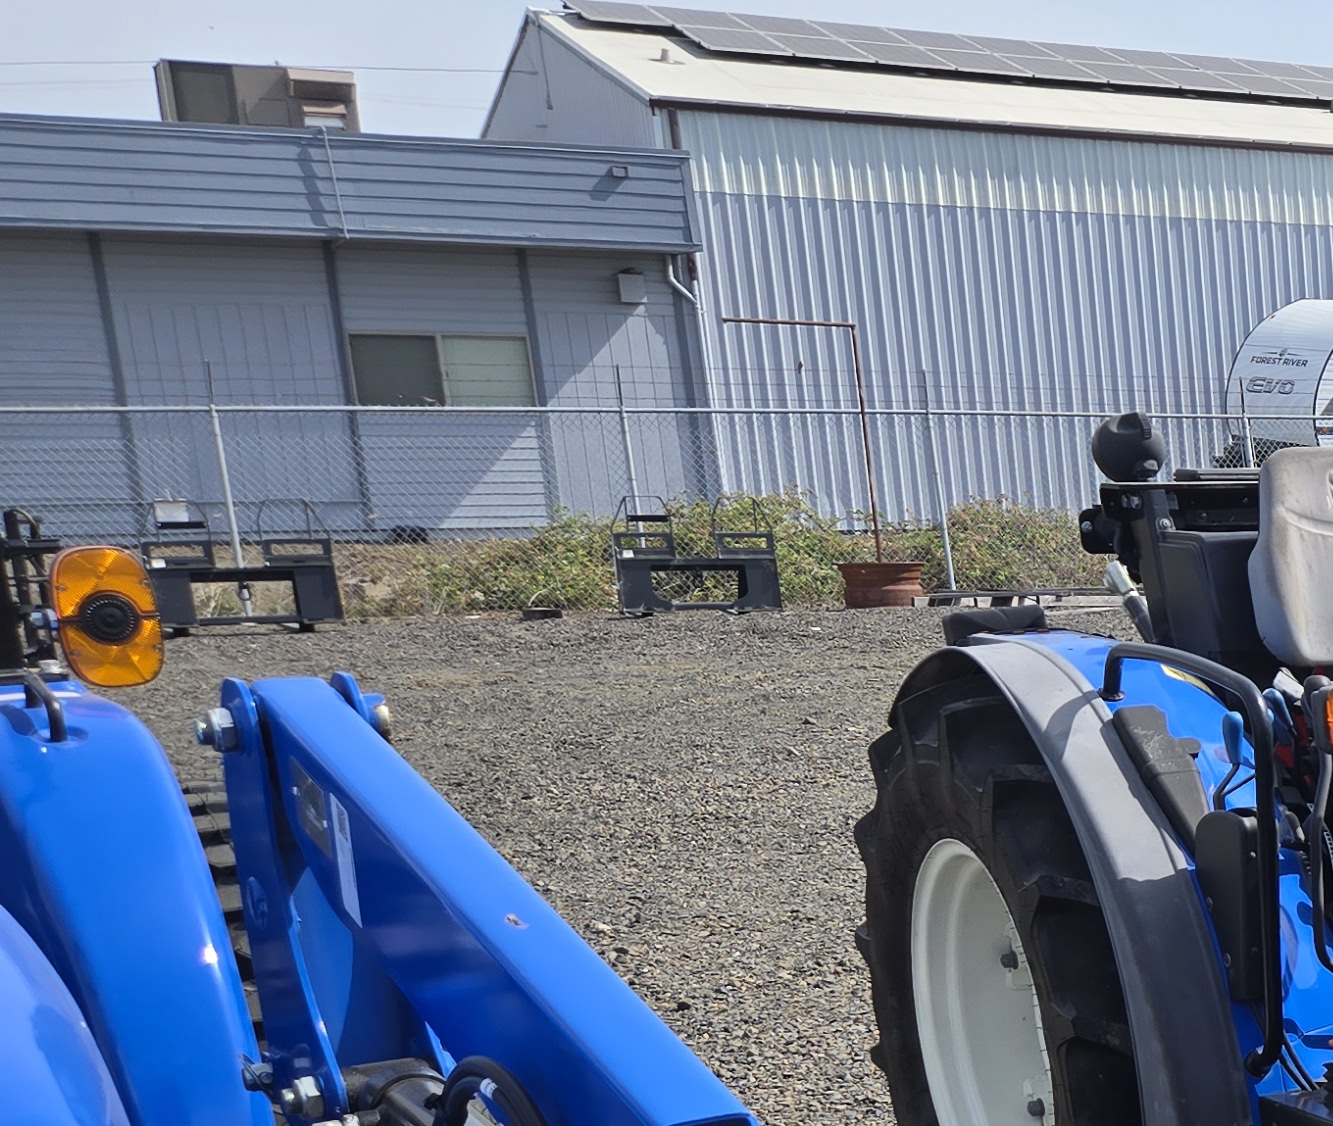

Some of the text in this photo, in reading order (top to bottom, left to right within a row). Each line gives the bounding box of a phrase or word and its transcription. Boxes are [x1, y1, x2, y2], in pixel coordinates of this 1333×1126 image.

[1250, 356, 1309, 368] FOREST RIVER
[1246, 376, 1295, 395] EVO
